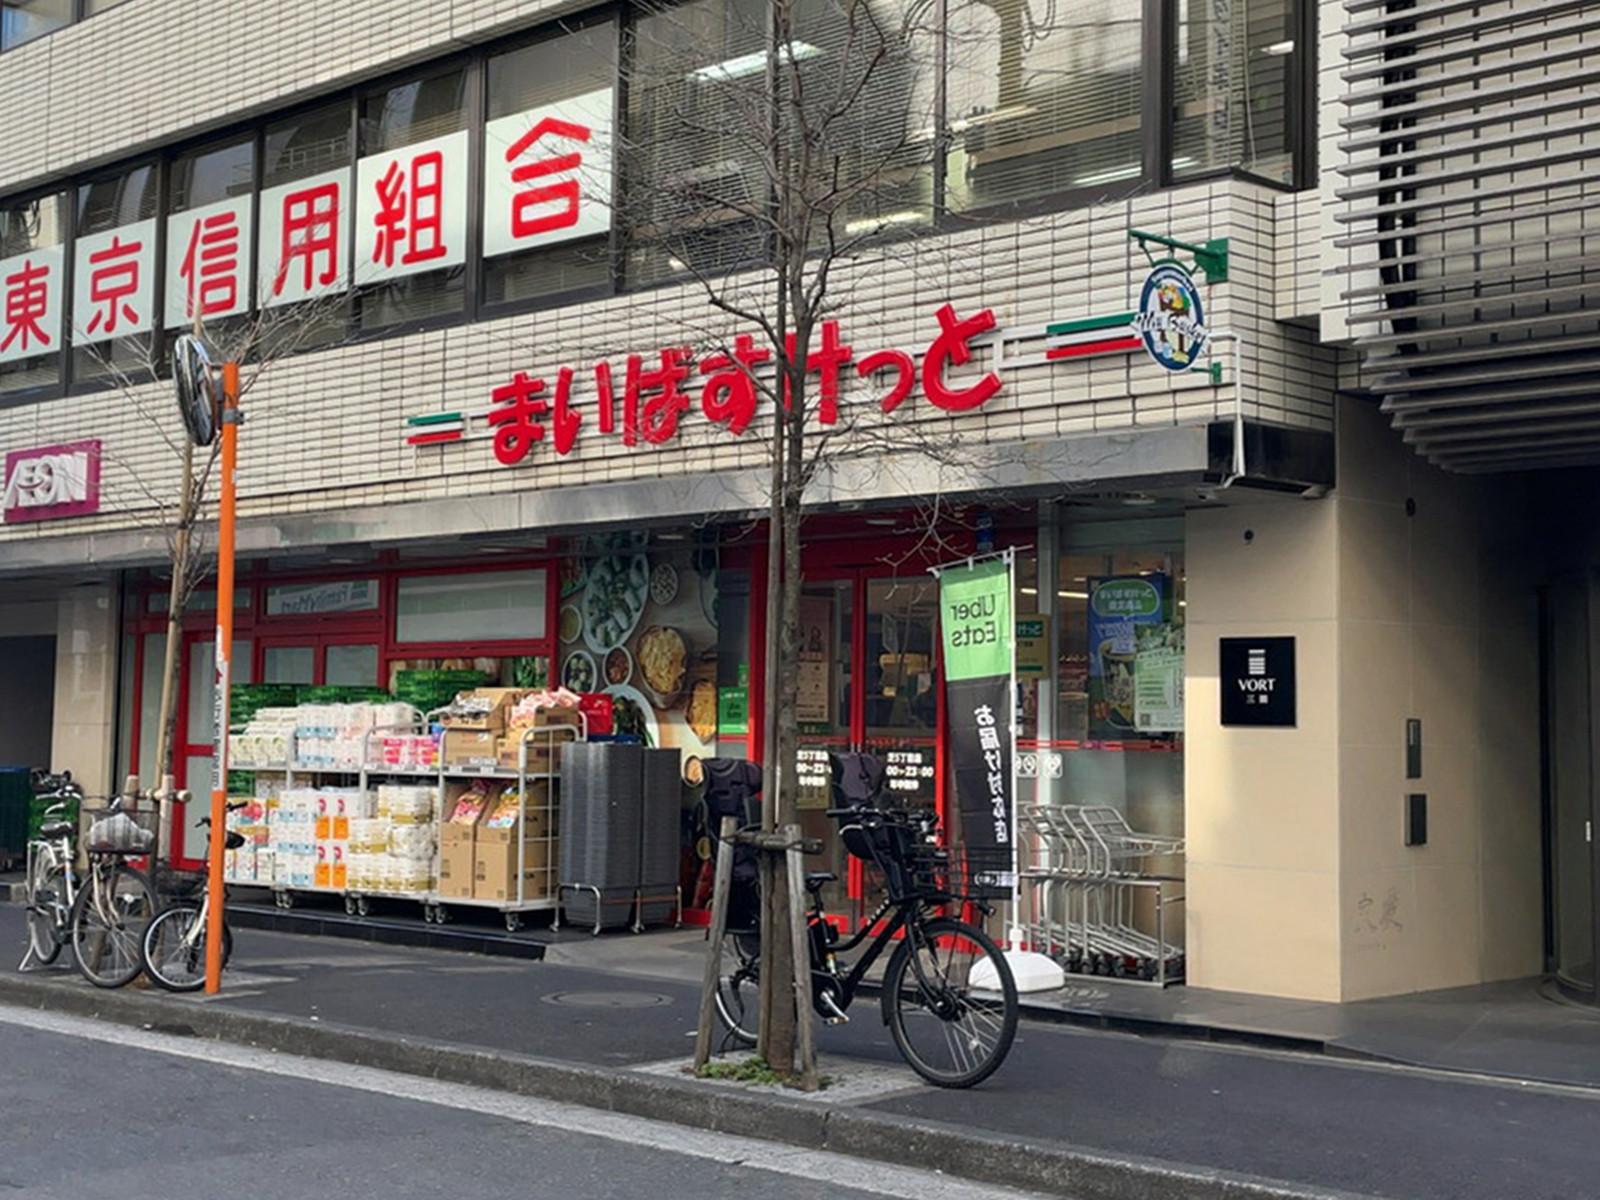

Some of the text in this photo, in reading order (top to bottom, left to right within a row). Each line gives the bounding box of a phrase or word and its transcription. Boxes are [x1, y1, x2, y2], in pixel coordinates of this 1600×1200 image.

[1, 116, 592, 352] 東京信用組合
[487, 302, 1003, 466] まいばすけっと
[1, 451, 88, 508] AEON
[1238, 678, 1276, 692] VORT
